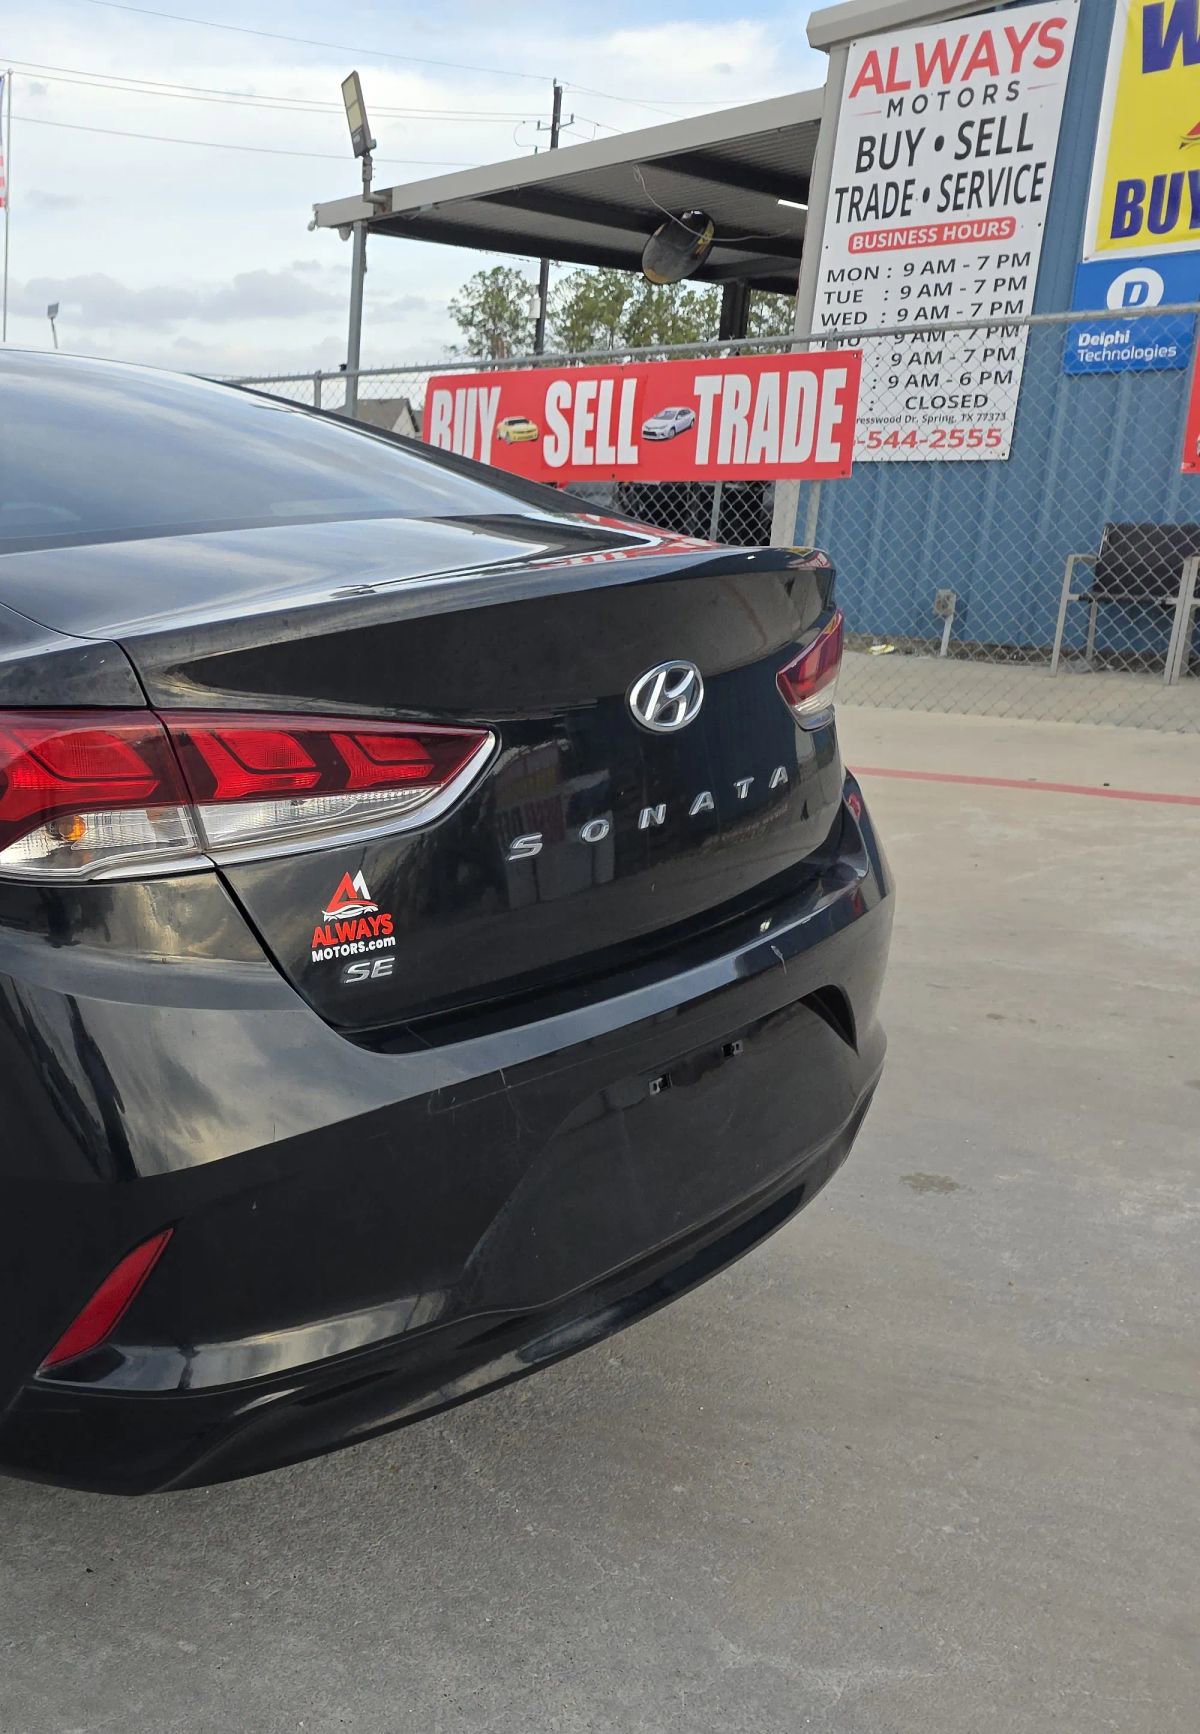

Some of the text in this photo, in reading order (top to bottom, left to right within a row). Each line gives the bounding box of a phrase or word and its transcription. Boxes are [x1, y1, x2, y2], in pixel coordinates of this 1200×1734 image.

[848, 17, 1068, 99] ALWAYS
[887, 80, 1021, 118] MOTORS
[855, 112, 1034, 174] BUY SELL
[835, 161, 1047, 224] TRADE SERVICE
[852, 219, 1011, 250] BUSINESS HOURS
[826, 265, 880, 283] MON
[903, 262, 915, 277] 9
[920, 258, 956, 275] AM
[977, 255, 990, 270] 7
[996, 251, 1031, 269] PM
[823, 289, 864, 305] TUE
[900, 285, 912, 300] 9
[916, 282, 953, 298] AM
[974, 279, 987, 294] 7
[993, 276, 1027, 293] PM
[821, 311, 868, 327] WED
[897, 308, 909, 322] 9
[913, 304, 950, 321] AM
[970, 303, 984, 317] 7
[989, 299, 1024, 316] PM
[986, 324, 1021, 340] PM
[1078, 329, 1131, 347] Delphi
[890, 353, 902, 367] 9
[907, 350, 943, 366] AM
[963, 349, 976, 363] 7
[982, 346, 1017, 362] PM
[1077, 344, 1177, 363] Technologies
[887, 375, 899, 389] 9
[904, 372, 940, 388] AM
[959, 371, 972, 386] 6
[979, 370, 1013, 385] PM
[905, 394, 988, 411] CLOSED
[429, 368, 848, 468] BUY SELL TRADE
[960, 413, 973, 422] TX
[976, 411, 1007, 423] 77373
[852, 427, 1002, 449] -544-2555
[506, 766, 790, 861] SONATA
[311, 913, 394, 949] ALWAYS
[311, 936, 396, 963] MOTORS.com
[343, 957, 396, 983] SE
